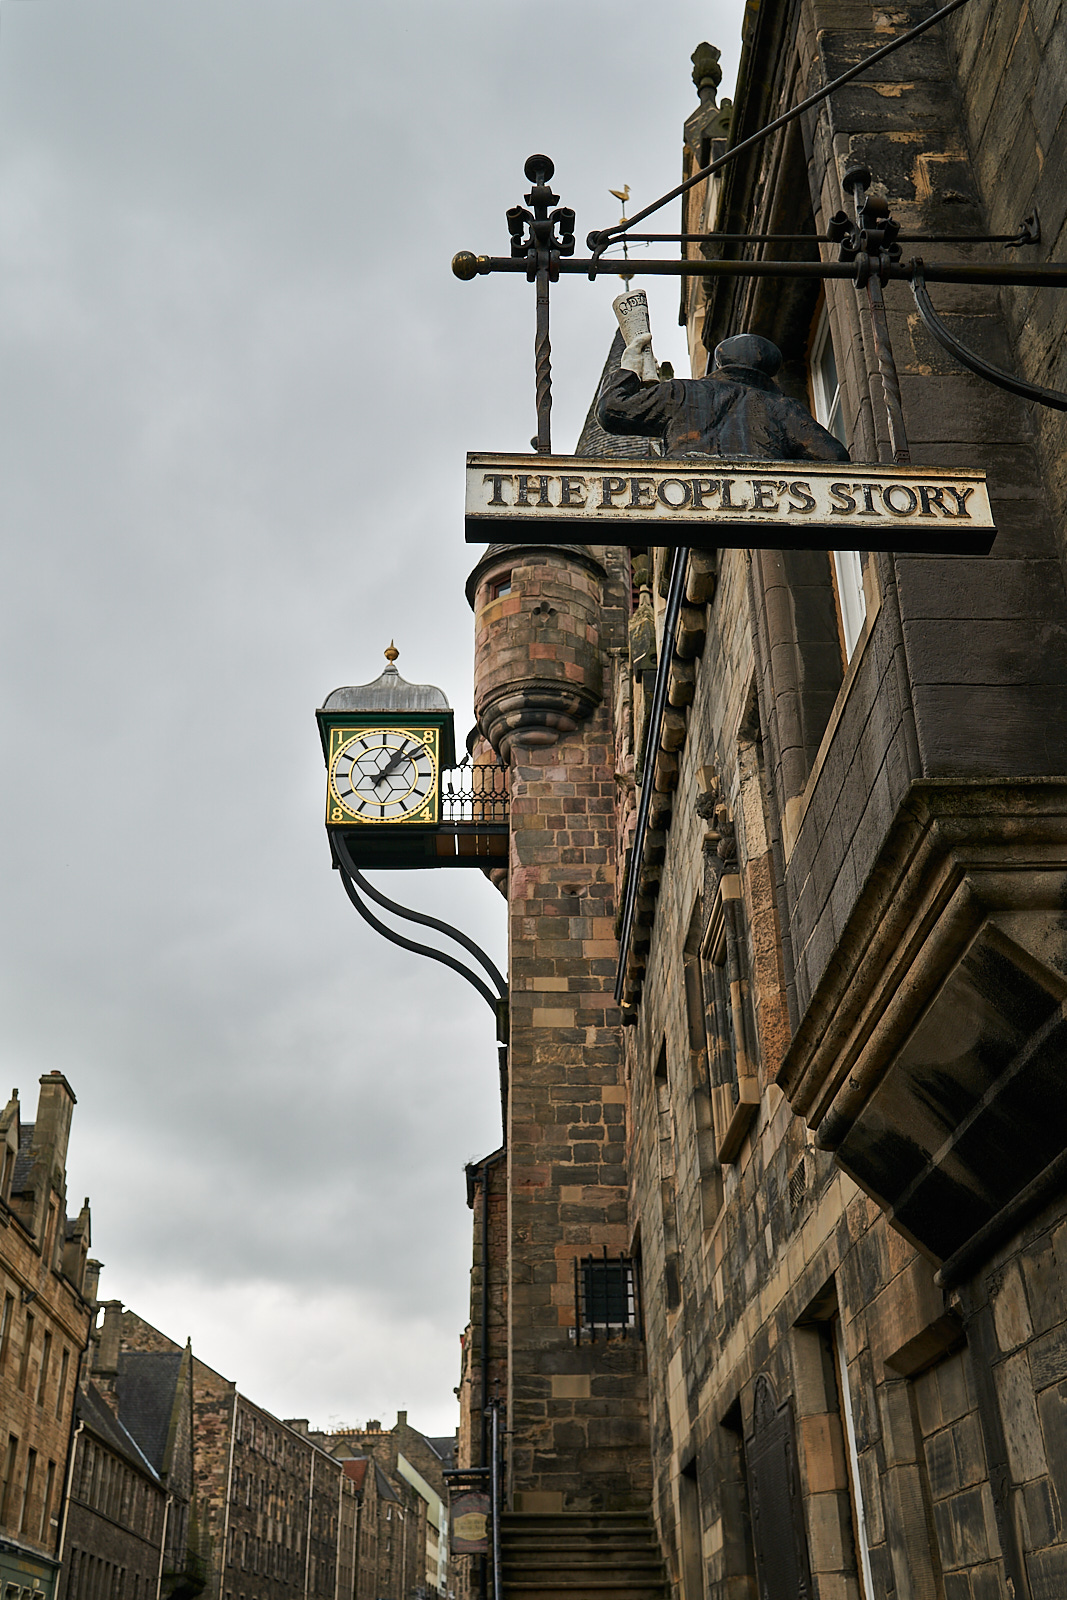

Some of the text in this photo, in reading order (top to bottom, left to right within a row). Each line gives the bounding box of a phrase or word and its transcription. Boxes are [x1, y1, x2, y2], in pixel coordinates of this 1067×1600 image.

[483, 473, 974, 519] THE PEOPLE'S STORY
[337, 730, 434, 745] 1 8
[331, 806, 432, 821] 8 4
